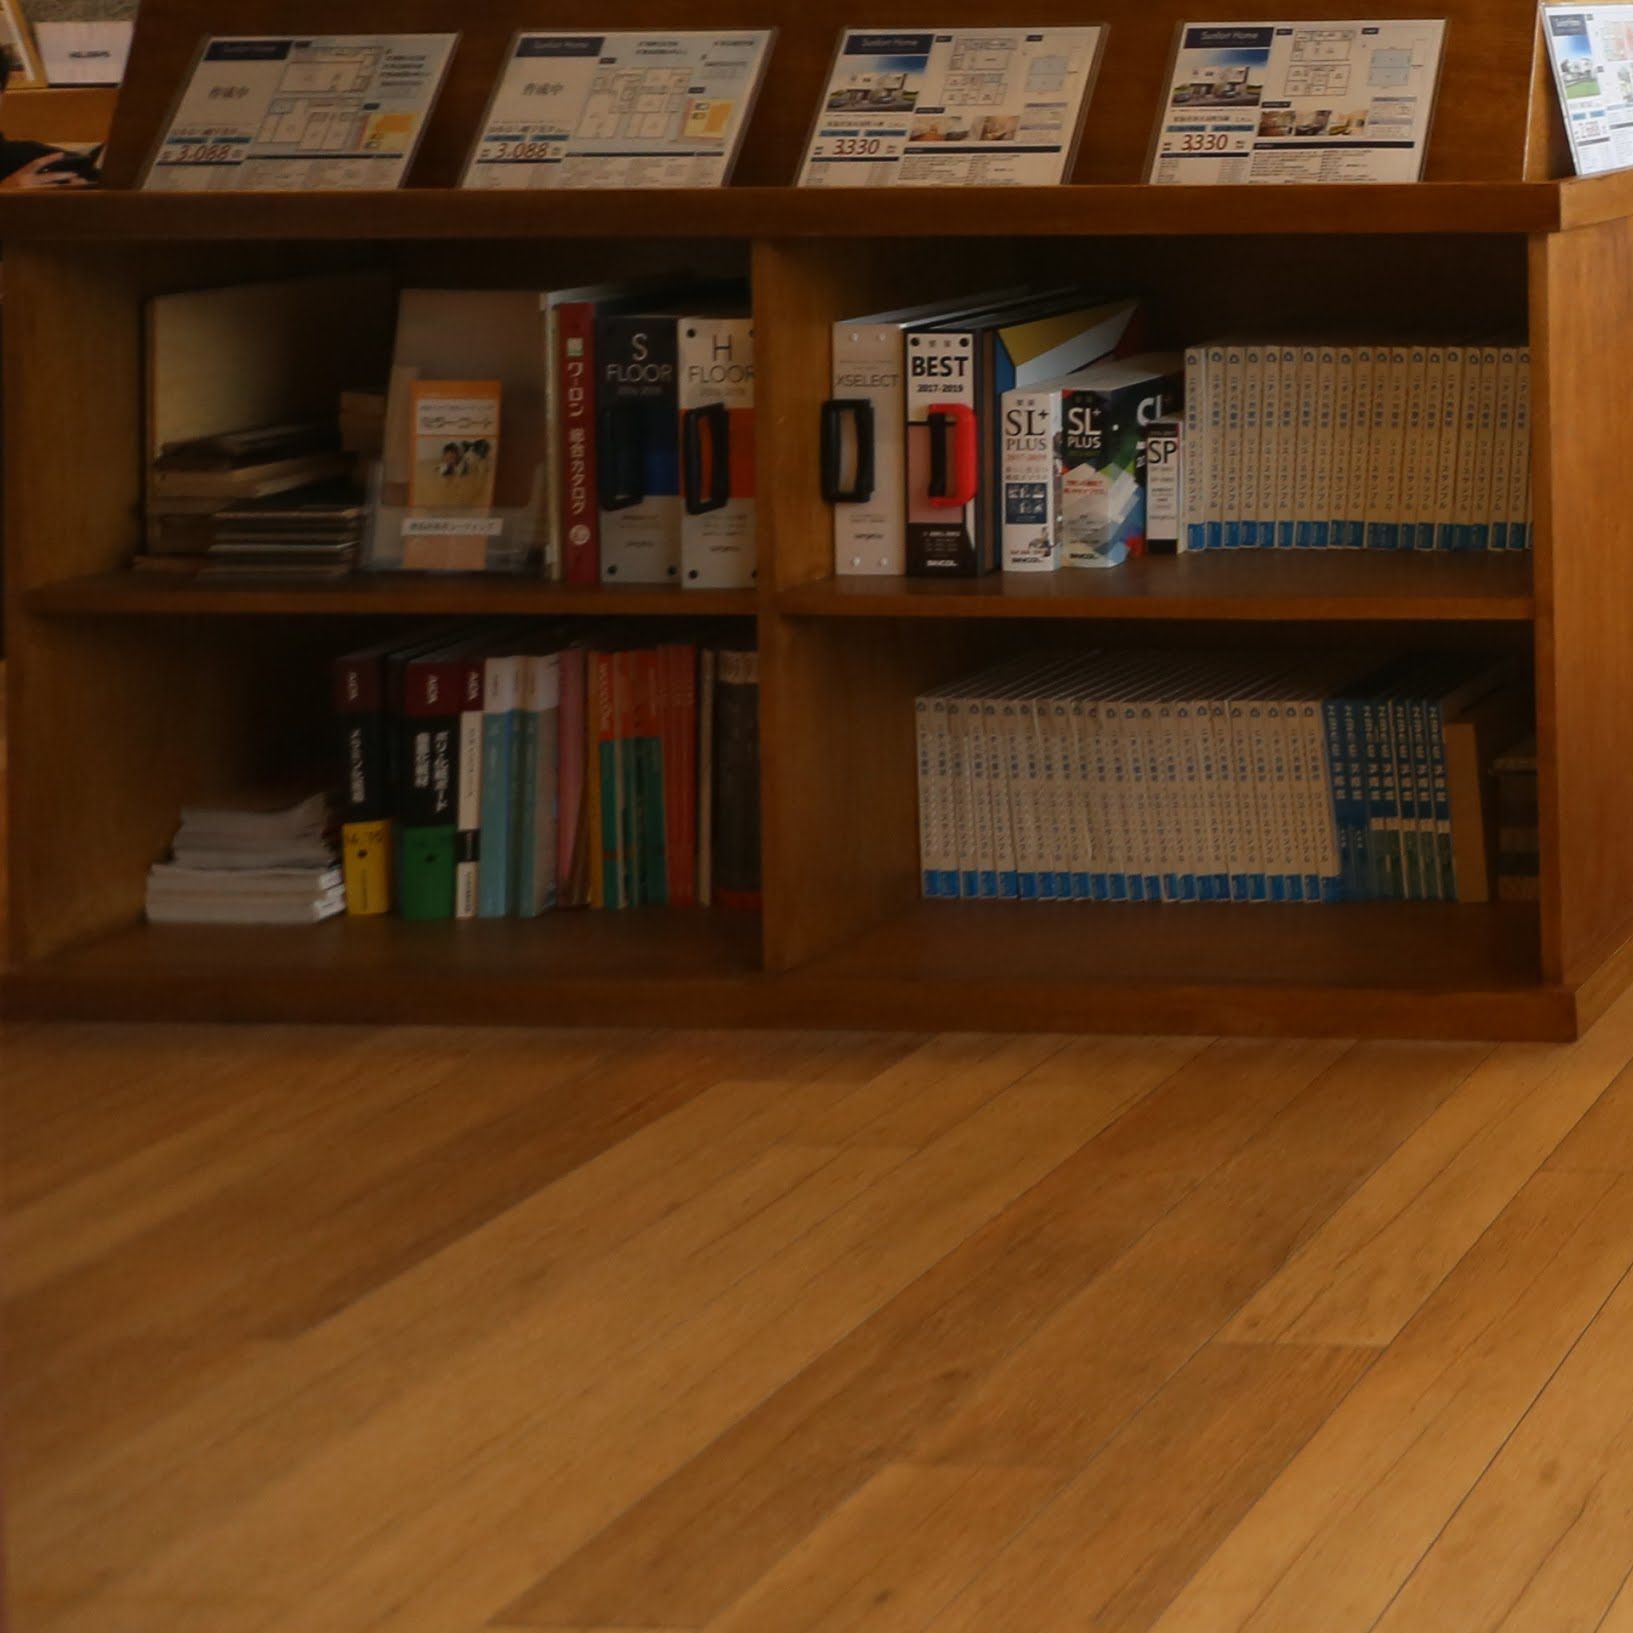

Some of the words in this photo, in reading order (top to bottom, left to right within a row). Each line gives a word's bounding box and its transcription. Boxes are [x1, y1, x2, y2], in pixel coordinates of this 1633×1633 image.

[631, 332, 649, 361] S
[713, 334, 732, 361] H
[606, 363, 673, 383] FLOOR
[912, 356, 969, 378] BEST
[1006, 437, 1047, 451] PLUS
[1067, 435, 1102, 449] PLUS
[1148, 440, 1177, 465] SP
